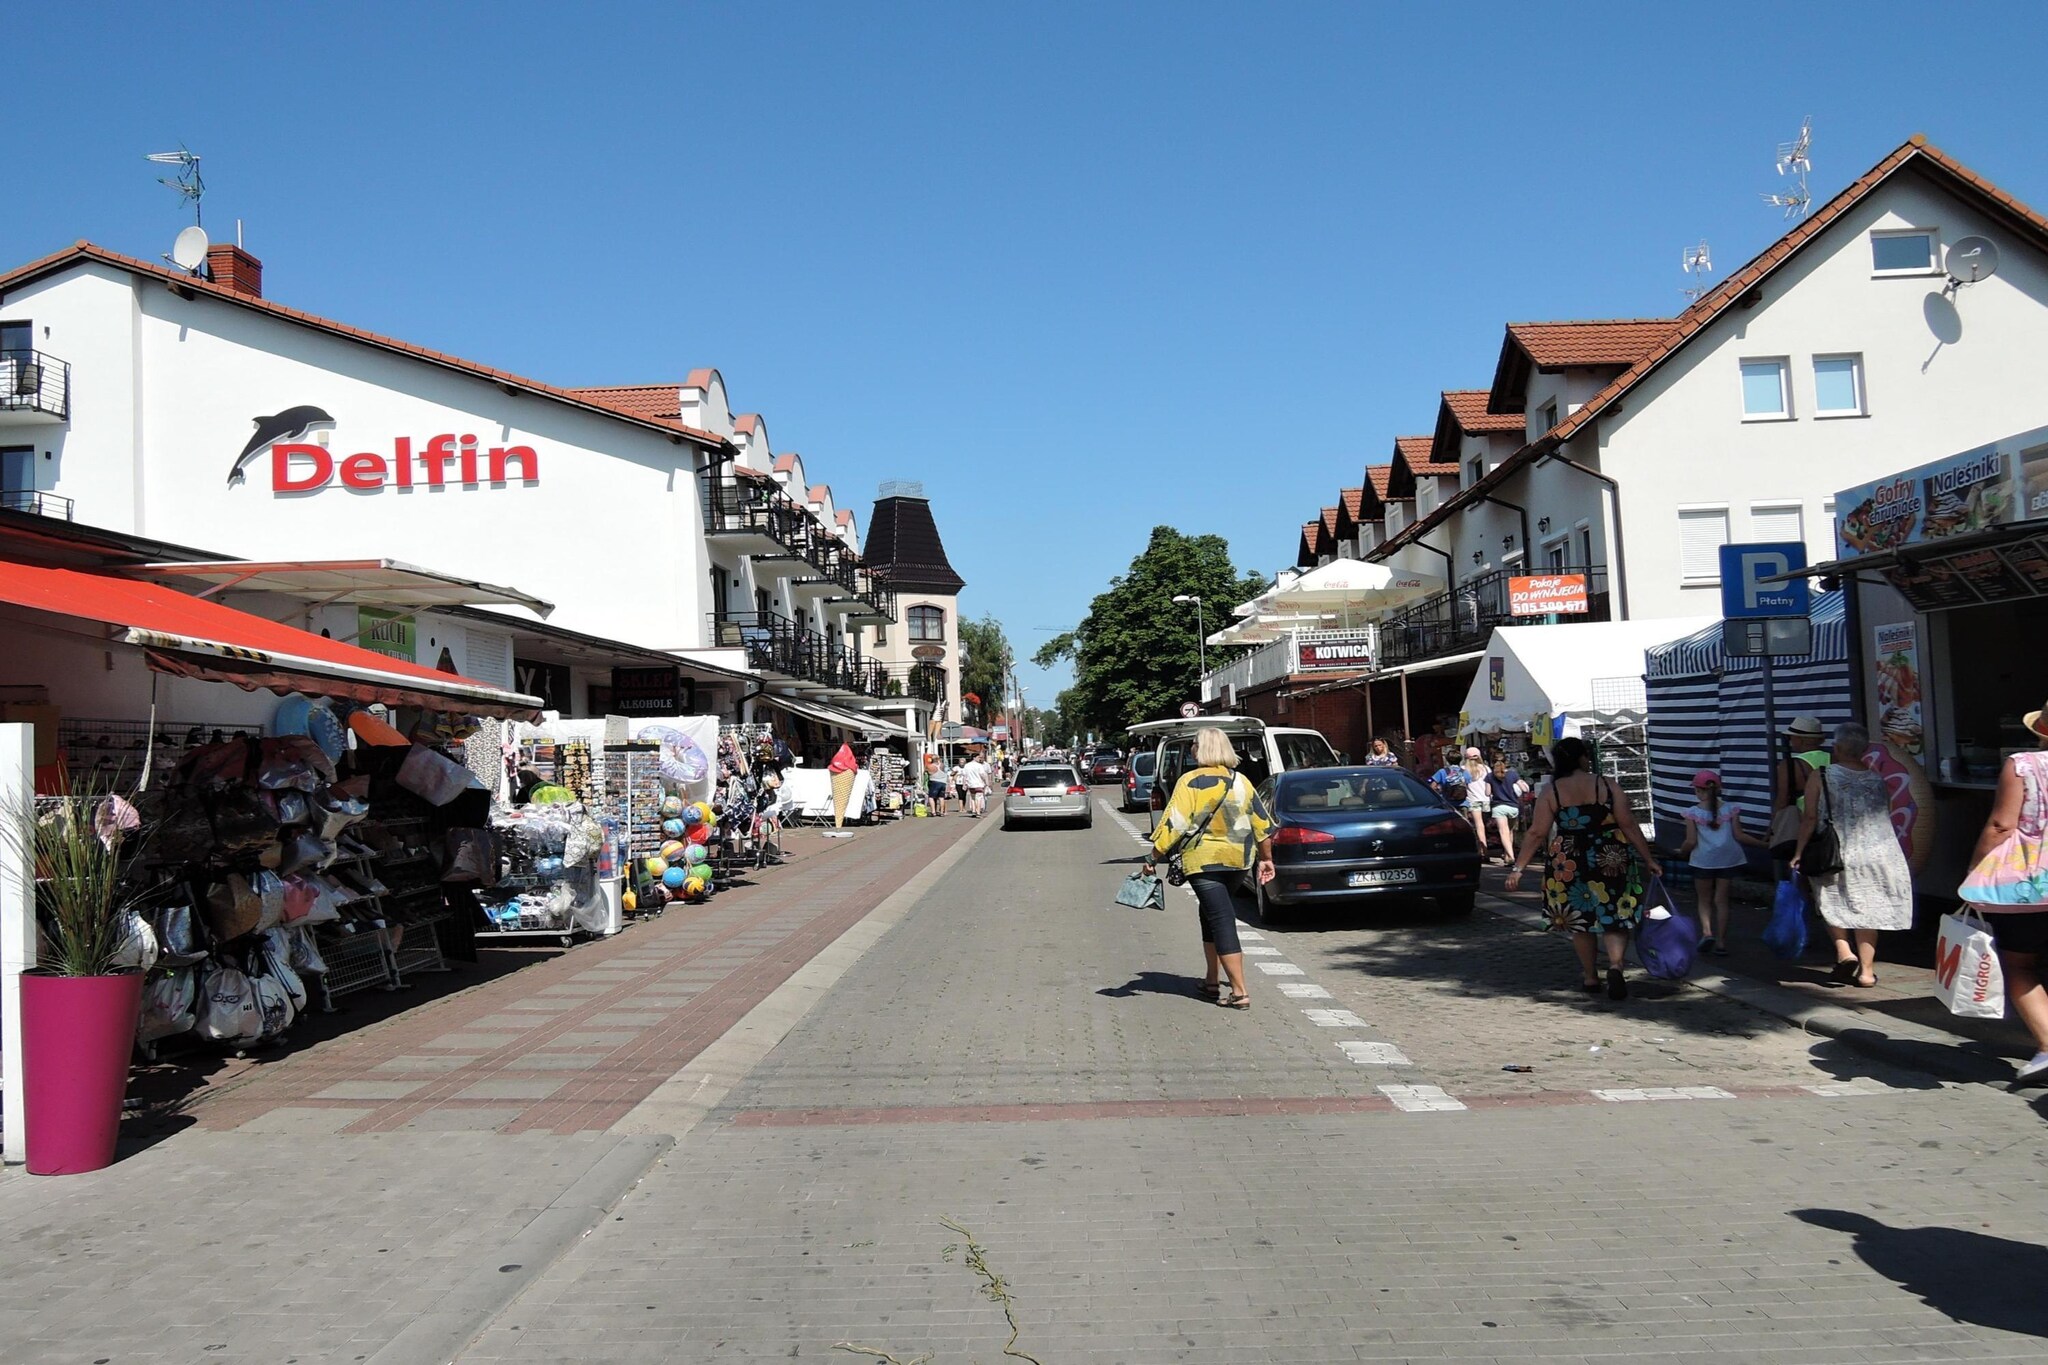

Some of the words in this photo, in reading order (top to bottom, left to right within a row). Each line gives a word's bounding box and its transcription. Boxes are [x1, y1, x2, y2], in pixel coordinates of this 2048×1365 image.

[272, 434, 538, 492] Delfin
[1932, 452, 2000, 496] Naleśniki
[1874, 479, 1914, 505] Gofry
[1868, 497, 1921, 525] chrupiące
[1529, 577, 1561, 589] Pokoje
[1741, 552, 1789, 608] P
[1512, 592, 1528, 602] DO
[1759, 597, 1794, 606] Płatny
[1315, 645, 1370, 660] KOTWICA
[618, 698, 673, 710] ALKOHOLE
[1354, 871, 1377, 883] ZKA
[1380, 868, 1415, 880] 02356
[1973, 953, 1991, 1002] MIGROS
